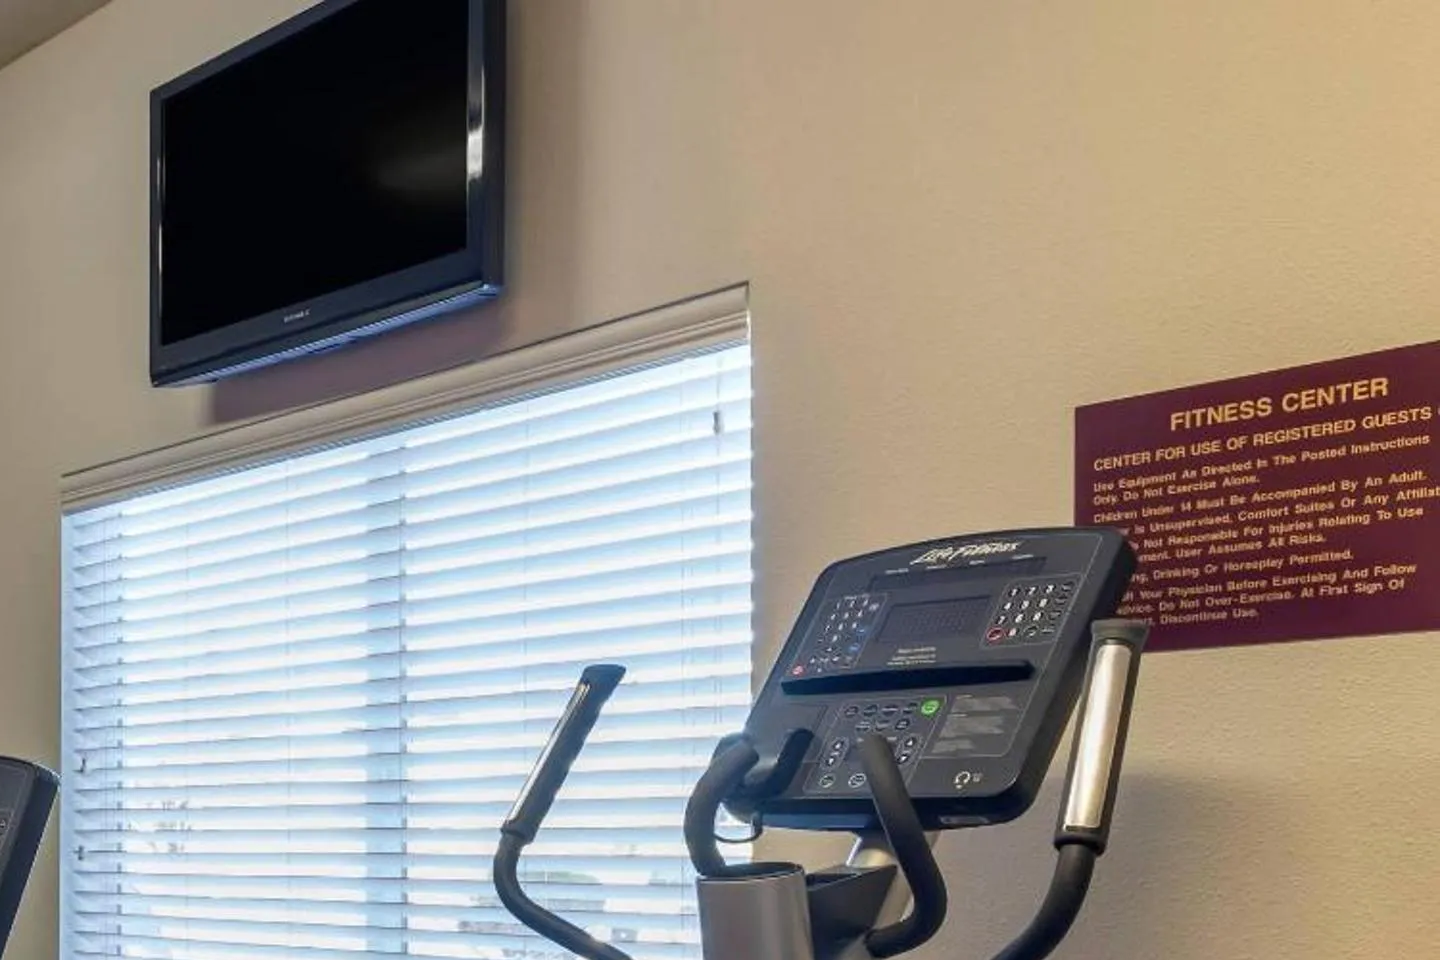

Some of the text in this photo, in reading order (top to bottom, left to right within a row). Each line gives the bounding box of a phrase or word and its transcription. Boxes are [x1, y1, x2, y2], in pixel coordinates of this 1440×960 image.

[1170, 377, 1389, 432] FITNESS CENTER
[1093, 406, 1432, 472] CENTER FOR USE OF REGISTERED GUESTS
[1093, 482, 1114, 493] Use
[1119, 471, 1177, 488] Equipment
[1202, 460, 1252, 476] Directed
[1274, 454, 1296, 466] The
[1301, 446, 1346, 462] Posted
[1351, 435, 1430, 454] Instructions
[1093, 510, 1137, 524] Children
[1142, 504, 1174, 517] Under
[1197, 498, 1224, 509] Must
[1230, 494, 1246, 504] Be
[1252, 481, 1335, 502] Accompanied
[1340, 479, 1358, 492] By
[1364, 476, 1383, 488] An
[1123, 491, 1139, 501] Do
[1143, 487, 1163, 499] Not
[1167, 480, 1216, 495] Exercise
[1222, 474, 1260, 487] Alone.
[1238, 506, 1289, 521] Comfort
[1295, 501, 1335, 515] Suites
[1340, 496, 1356, 508] Or
[1363, 494, 1389, 506] Any
[1144, 538, 1163, 549] Not
[1168, 530, 1239, 547] Responsible
[1244, 525, 1264, 537] For
[1269, 521, 1313, 535] Injuries
[1318, 513, 1371, 528] Relating
[1376, 510, 1392, 520] To
[1397, 507, 1424, 518] Use
[1176, 547, 1202, 558] User
[1209, 539, 1262, 555] Assumes
[1289, 533, 1327, 546] Risks.
[1153, 566, 1200, 578] Drinking
[1204, 563, 1219, 574] Or
[1224, 557, 1284, 572] Horseplay
[1290, 549, 1354, 565] Permitted.
[1140, 590, 1163, 600] Your
[1168, 583, 1222, 598] Physician
[1227, 579, 1268, 592] Before
[1272, 571, 1337, 587] Exercising
[1343, 567, 1369, 579] And
[1373, 563, 1418, 577] Follow
[1300, 586, 1314, 598] At
[1319, 584, 1348, 596] First
[1354, 581, 1383, 594] Sign
[1388, 578, 1405, 591] Of
[1160, 610, 1227, 625] Discontinue
